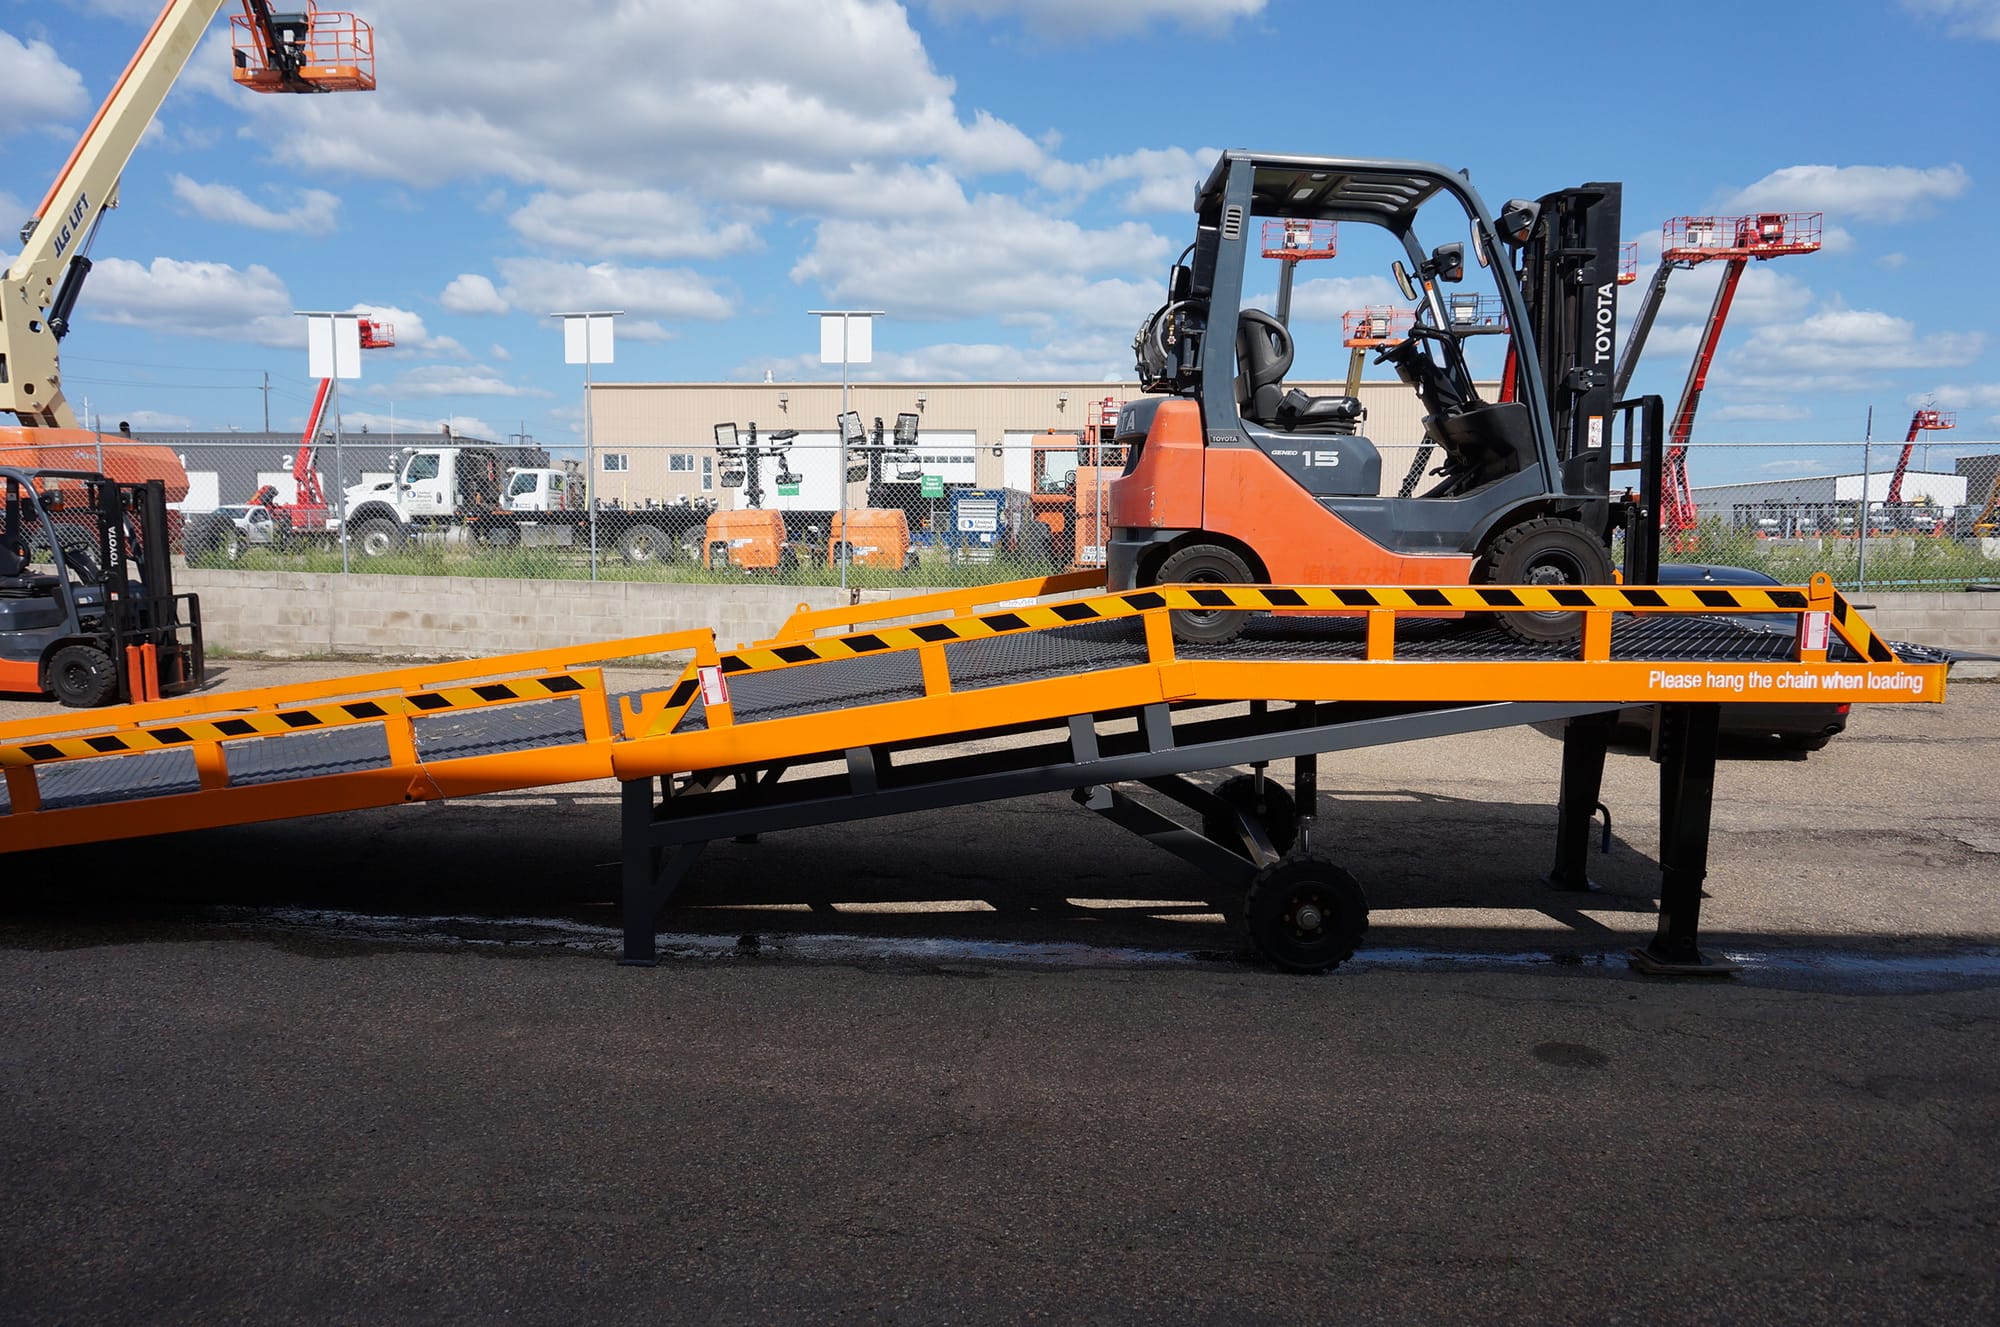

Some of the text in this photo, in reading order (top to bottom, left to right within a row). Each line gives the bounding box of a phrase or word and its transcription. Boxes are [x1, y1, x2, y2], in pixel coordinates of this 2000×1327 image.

[54, 192, 89, 258] JLG LIFT
[1595, 283, 1614, 364] TOYOTA
[282, 455, 294, 470] 2
[1302, 451, 1339, 467] 15
[109, 526, 119, 567] TOYOTA
[1649, 671, 1924, 694] Please hang the chain when loading
